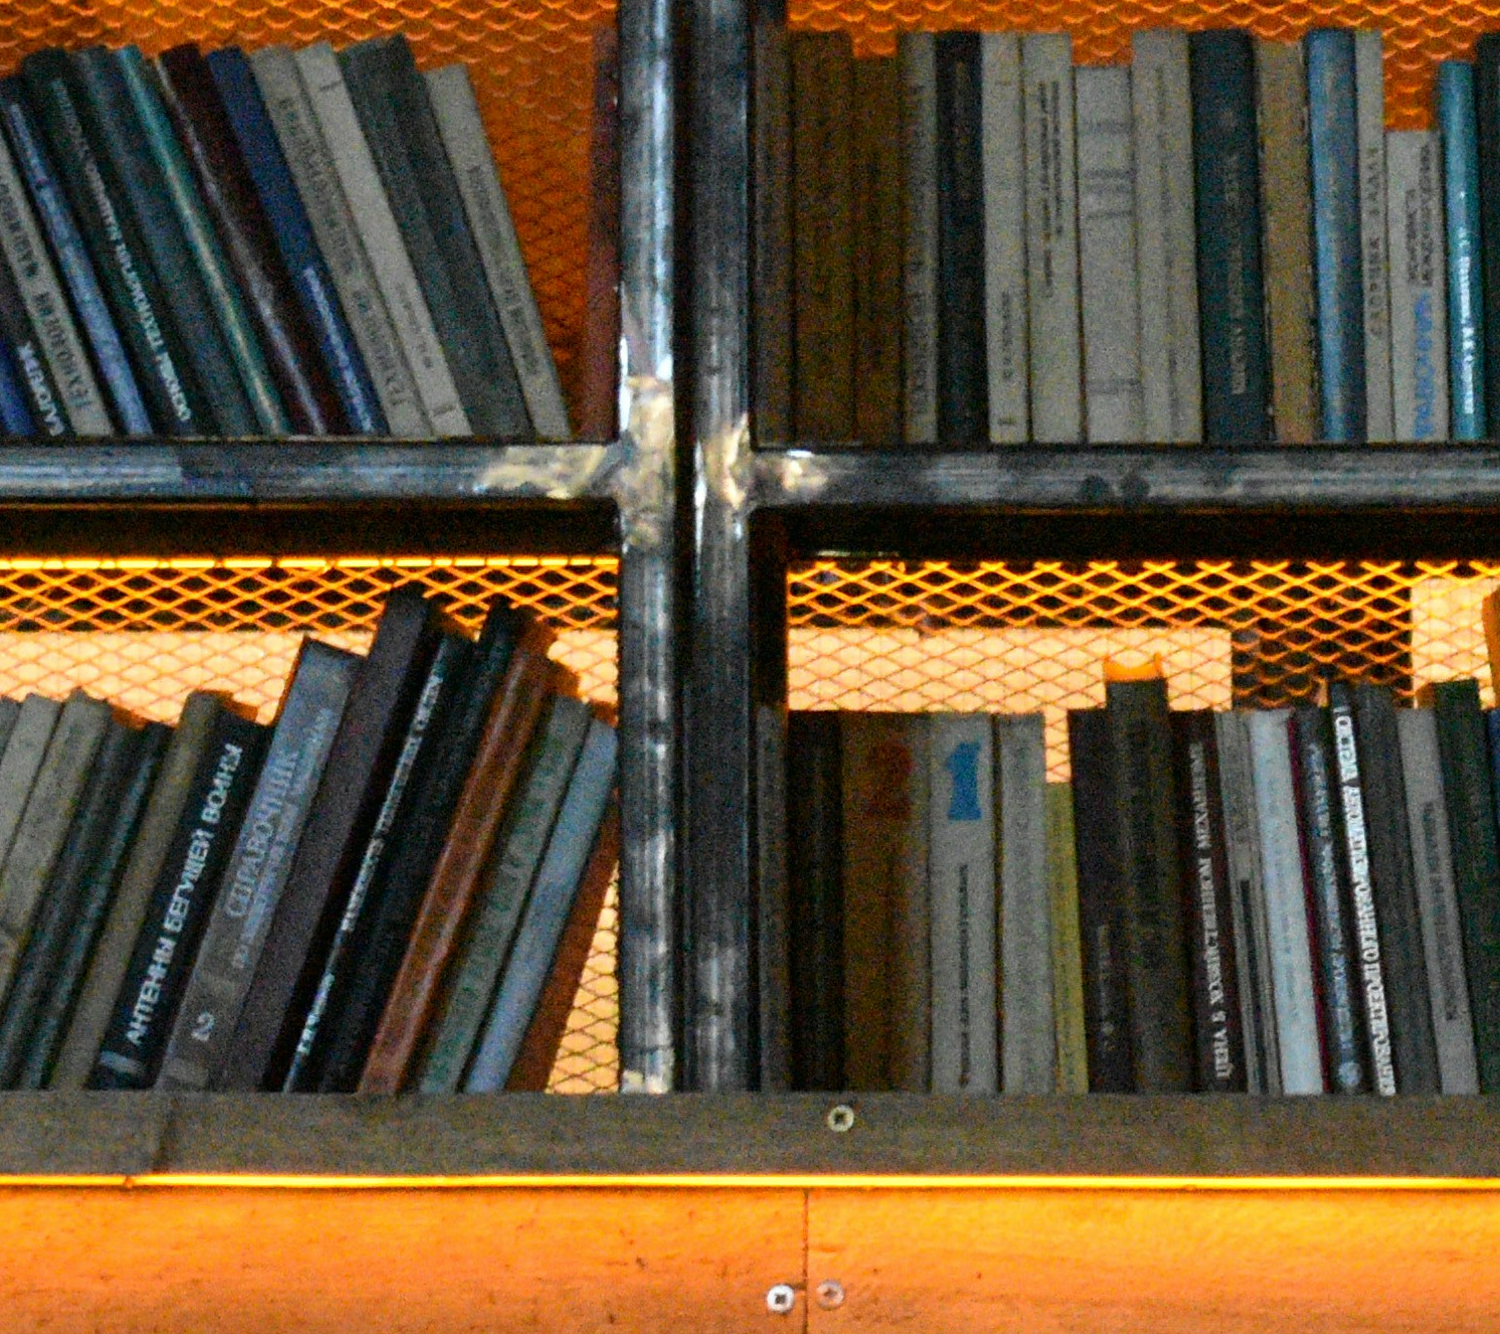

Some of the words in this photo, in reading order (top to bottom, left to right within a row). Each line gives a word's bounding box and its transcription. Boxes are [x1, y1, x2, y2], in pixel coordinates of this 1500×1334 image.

[219, 743, 306, 923] СПРАВОЧНИК
[945, 742, 982, 820] 1
[124, 923, 175, 1047] АНТЕННЫ
[161, 825, 215, 936] БЕГУЩЕЙ
[200, 743, 244, 827] ВОЛНЫ
[191, 1010, 216, 1044] 2
